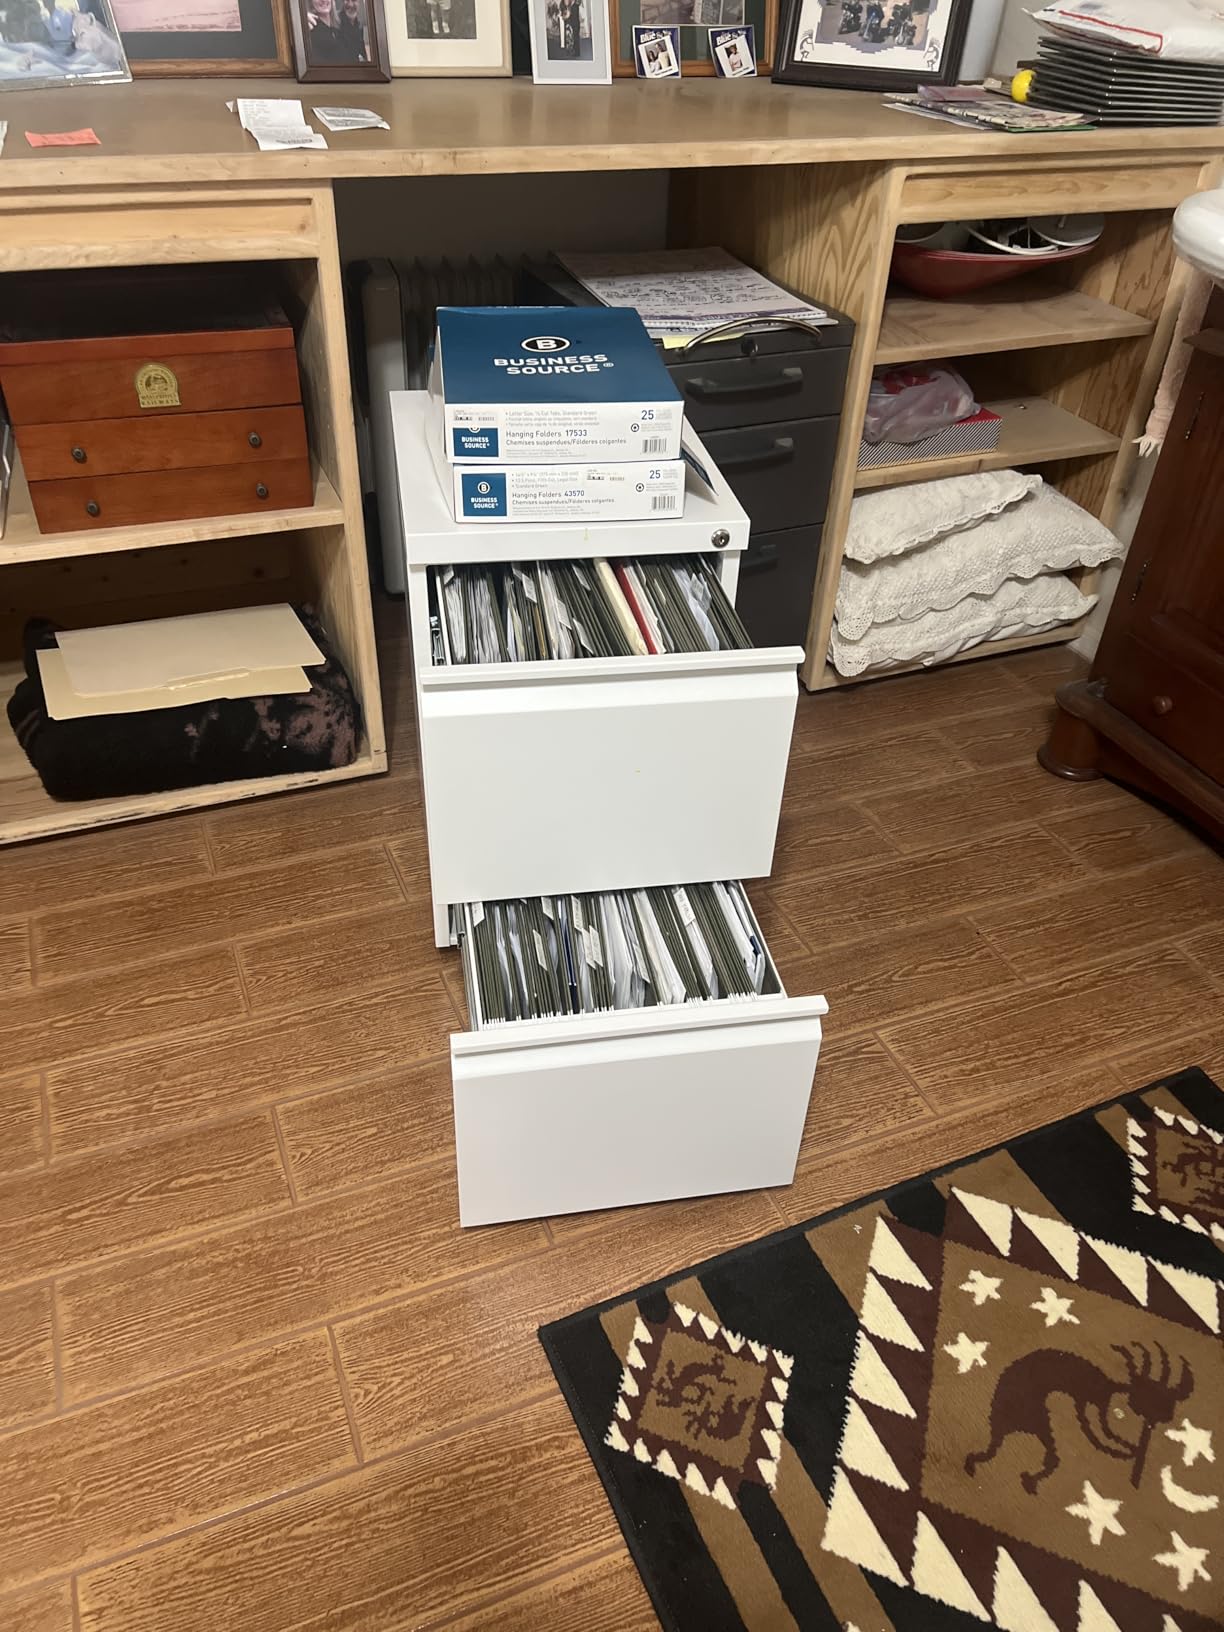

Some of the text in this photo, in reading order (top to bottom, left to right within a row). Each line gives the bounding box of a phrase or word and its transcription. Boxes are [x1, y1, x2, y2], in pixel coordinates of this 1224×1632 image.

[493, 354, 608, 366] BUSINESS
[641, 409, 654, 420] 25
[505, 429, 588, 439] Hanging Folders 17533
[649, 469, 661, 480] 25
[512, 491, 537, 499] Hanging
[564, 489, 585, 497] 43570
